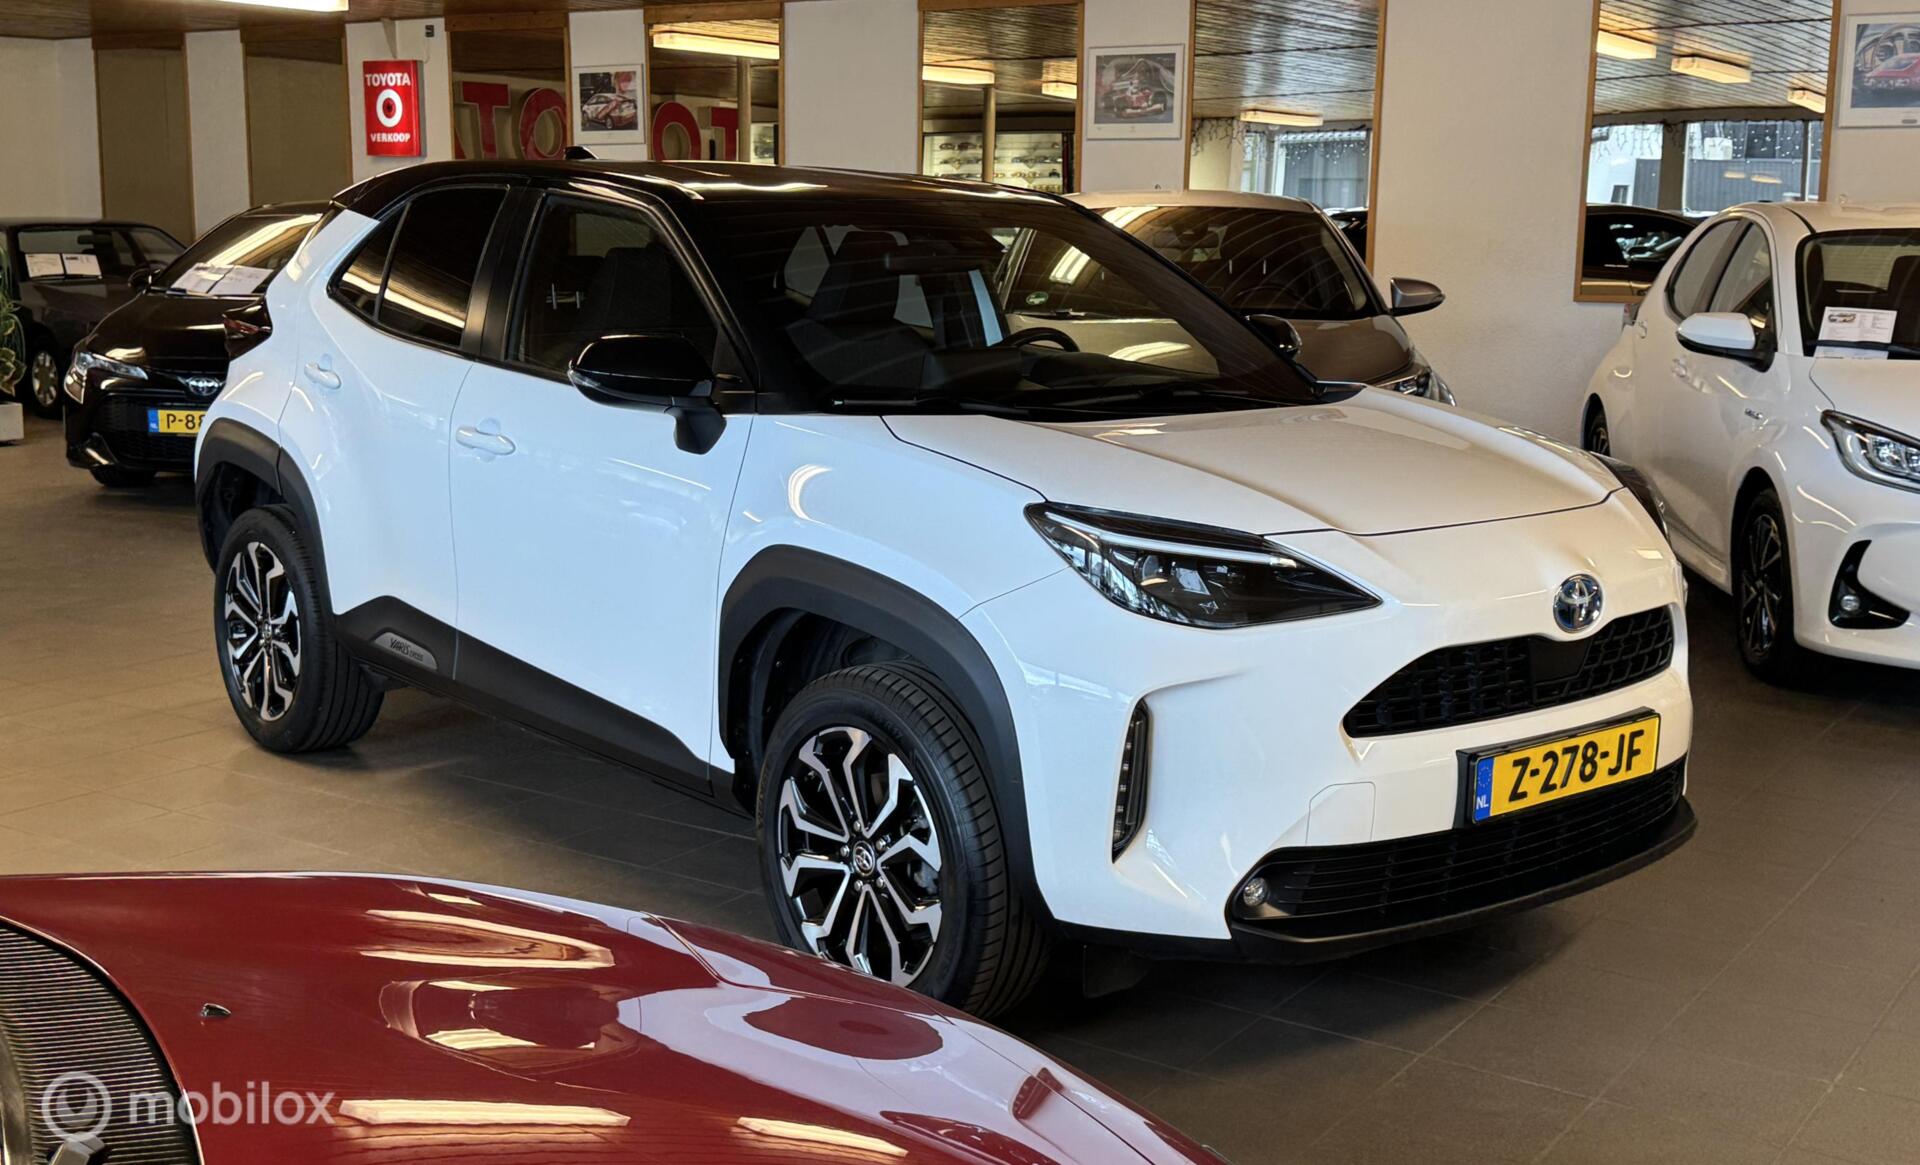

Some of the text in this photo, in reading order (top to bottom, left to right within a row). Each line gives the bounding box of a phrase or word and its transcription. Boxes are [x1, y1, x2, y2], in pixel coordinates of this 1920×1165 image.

[365, 73, 411, 87] TOYOTA
[370, 132, 411, 143] VERKOOP
[1508, 729, 1645, 803] Z-278-JF
[1476, 796, 1489, 810] NL
